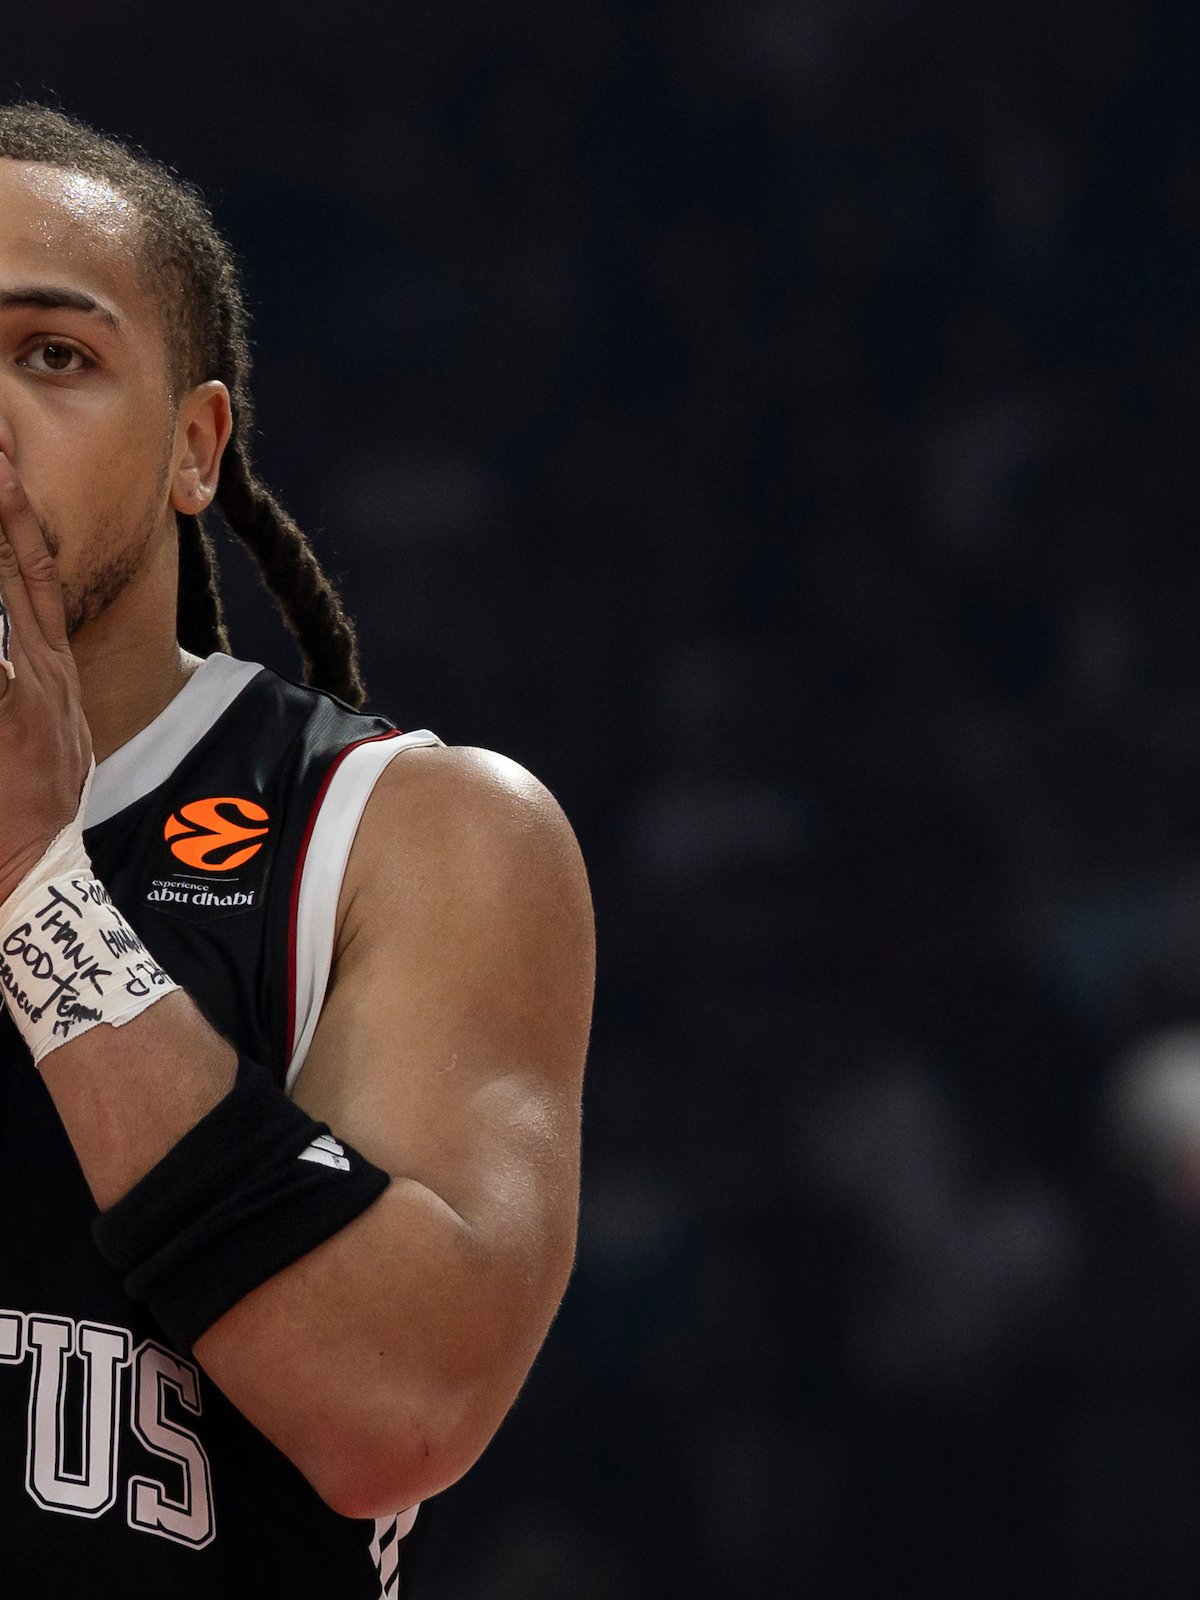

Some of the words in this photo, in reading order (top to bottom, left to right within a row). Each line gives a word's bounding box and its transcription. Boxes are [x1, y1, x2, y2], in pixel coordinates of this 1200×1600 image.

[146, 887, 190, 904] abu
[191, 890, 256, 907] dhabi
[152, 879, 210, 892] experience
[2, 922, 54, 980] GOD
[35, 885, 112, 997] THANK
